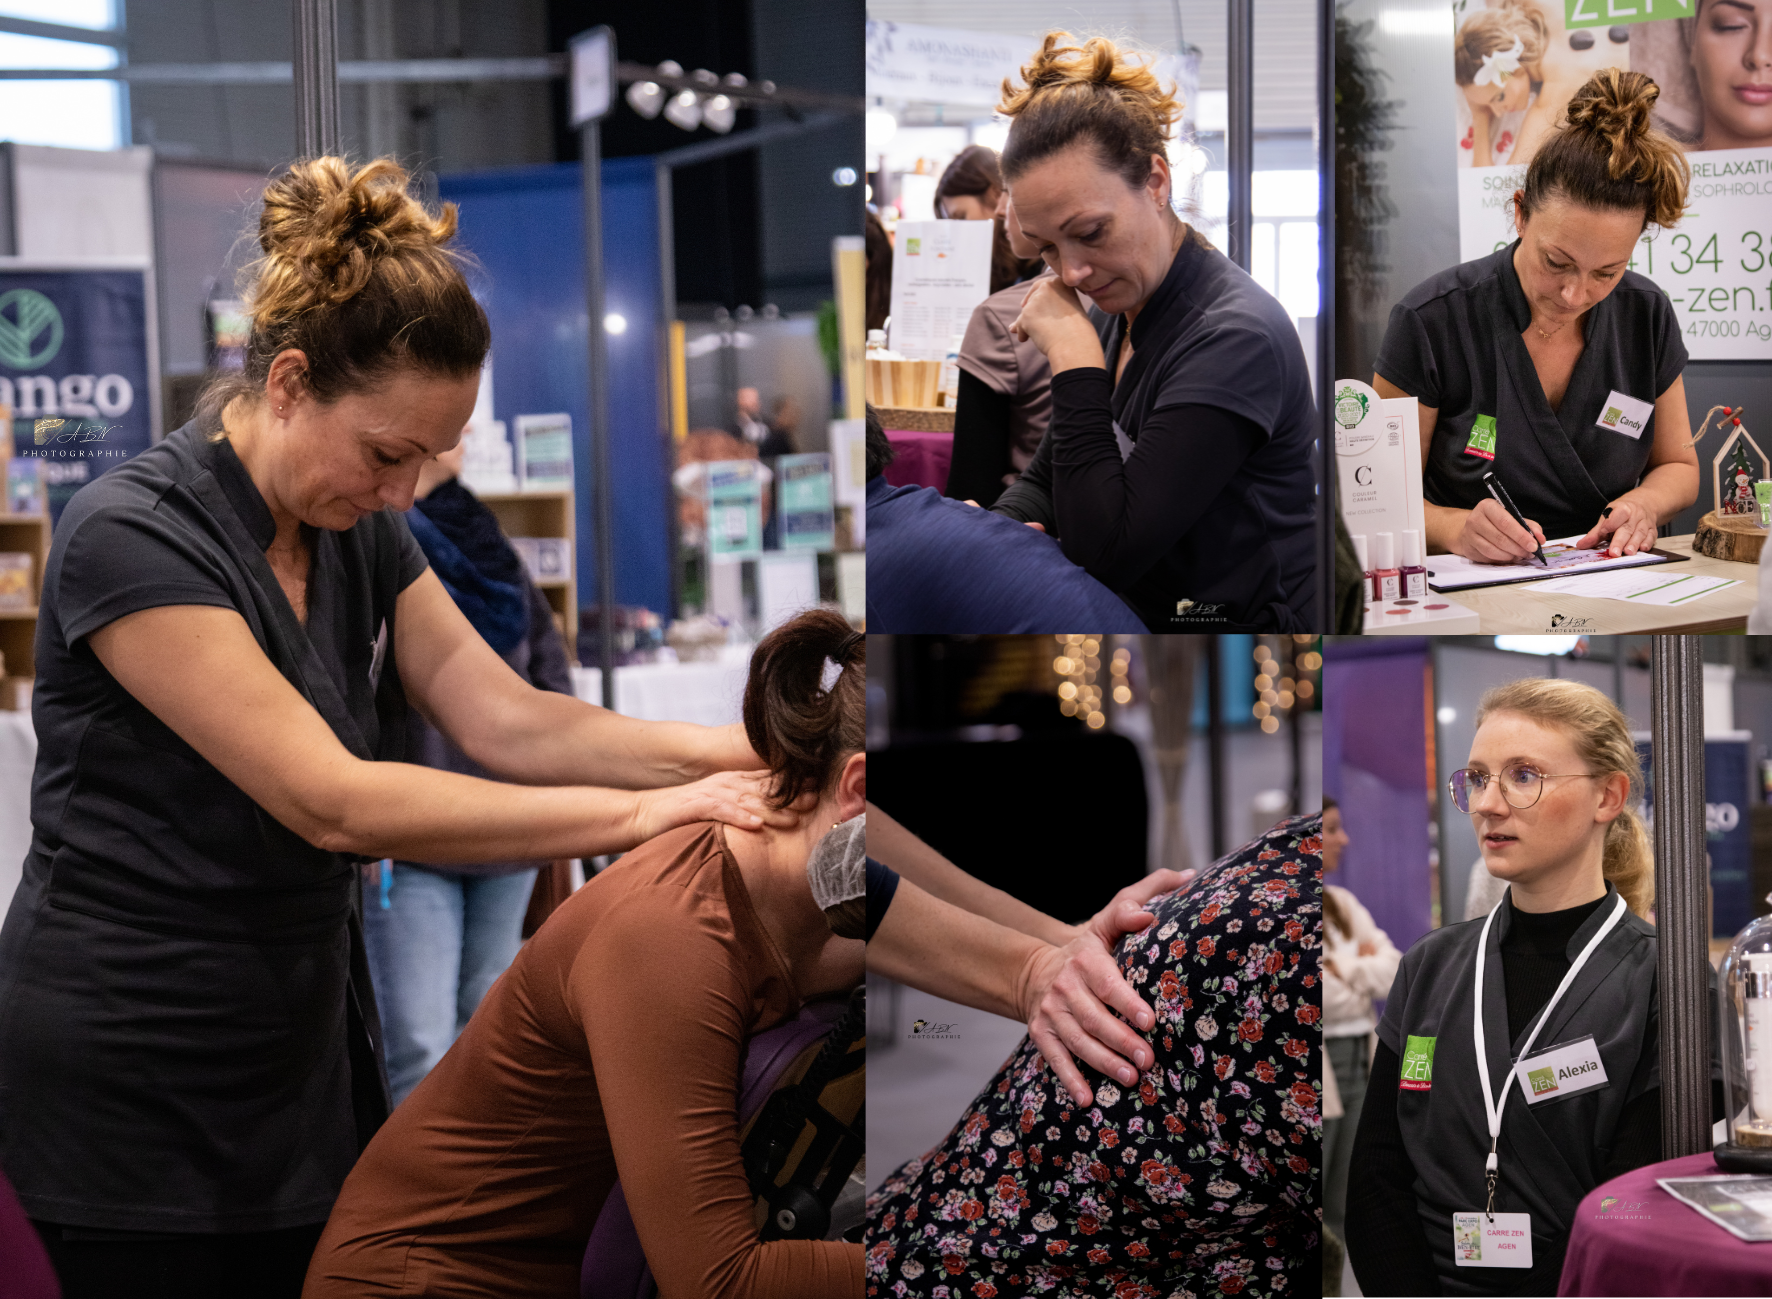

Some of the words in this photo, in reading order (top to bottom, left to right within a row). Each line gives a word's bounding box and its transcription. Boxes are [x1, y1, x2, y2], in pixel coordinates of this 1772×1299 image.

[1692, 160, 1772, 178] RELAXATI
[1627, 236, 1653, 275] 1
[1671, 232, 1723, 275] 34
[1741, 230, 1772, 273] 3
[1686, 320, 1740, 338] 47000
[1620, 416, 1642, 431] Candy
[1559, 1061, 1598, 1080] Alexia
[1532, 1077, 1557, 1093] ZEN
